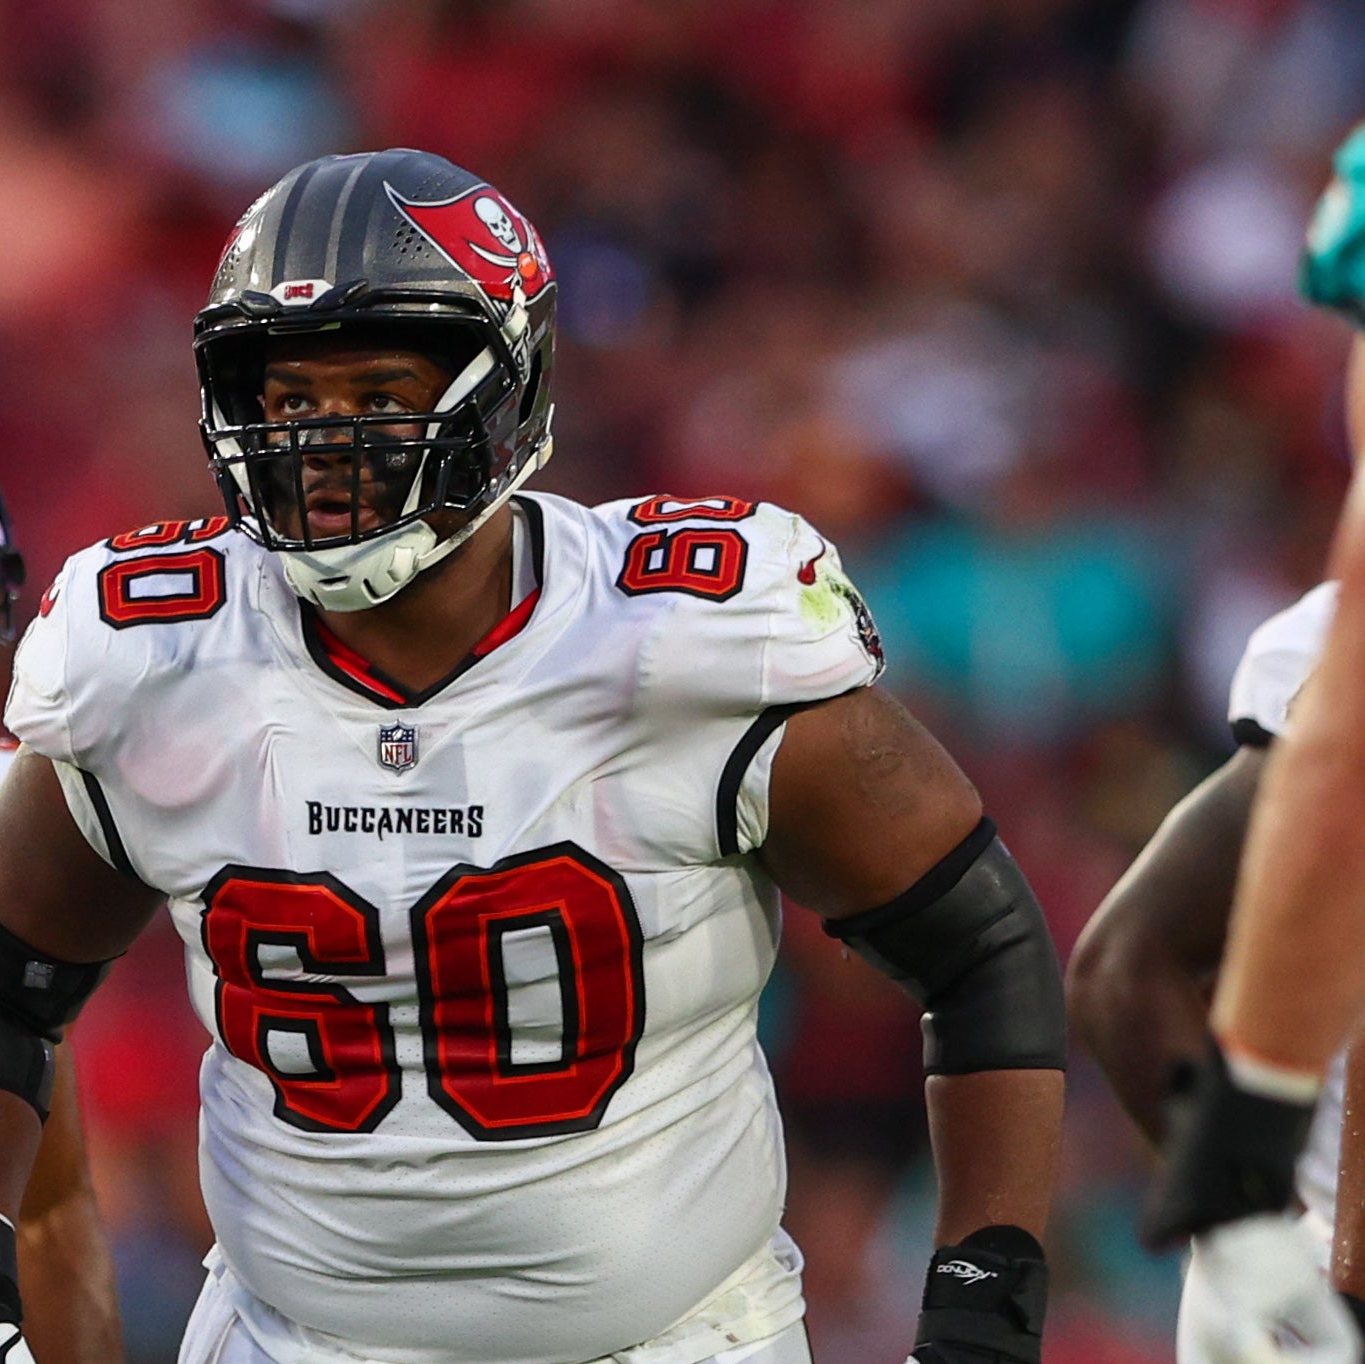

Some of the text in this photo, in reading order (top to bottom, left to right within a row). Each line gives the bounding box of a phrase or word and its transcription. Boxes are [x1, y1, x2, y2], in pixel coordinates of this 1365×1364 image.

[615, 494, 759, 604] 60
[384, 744, 412, 765] NFL
[305, 800, 484, 841] BUCCANEERS
[201, 841, 644, 1141] 60
